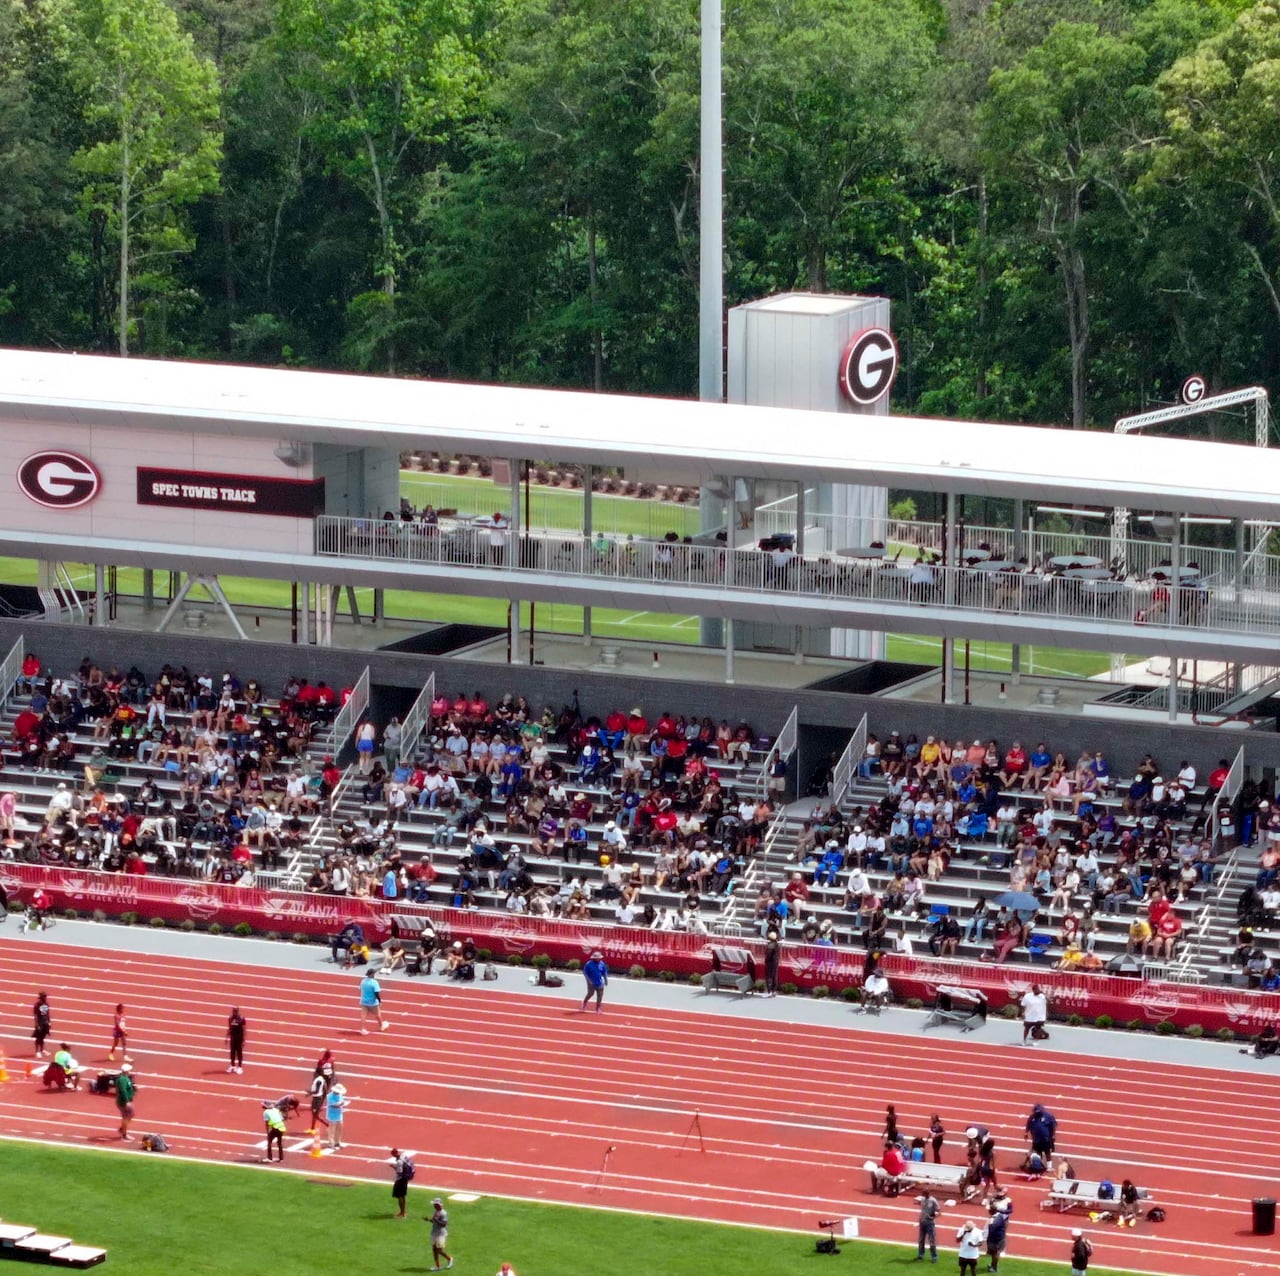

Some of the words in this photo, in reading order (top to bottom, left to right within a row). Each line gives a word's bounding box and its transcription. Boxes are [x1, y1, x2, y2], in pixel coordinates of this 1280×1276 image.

[152, 482, 180, 497] SPEC
[181, 484, 218, 500] TOWNS
[220, 487, 256, 503] TRACK
[87, 882, 139, 899] ATLANTA
[288, 901, 339, 919] ATLANTA
[607, 939, 659, 956] ATLANTA
